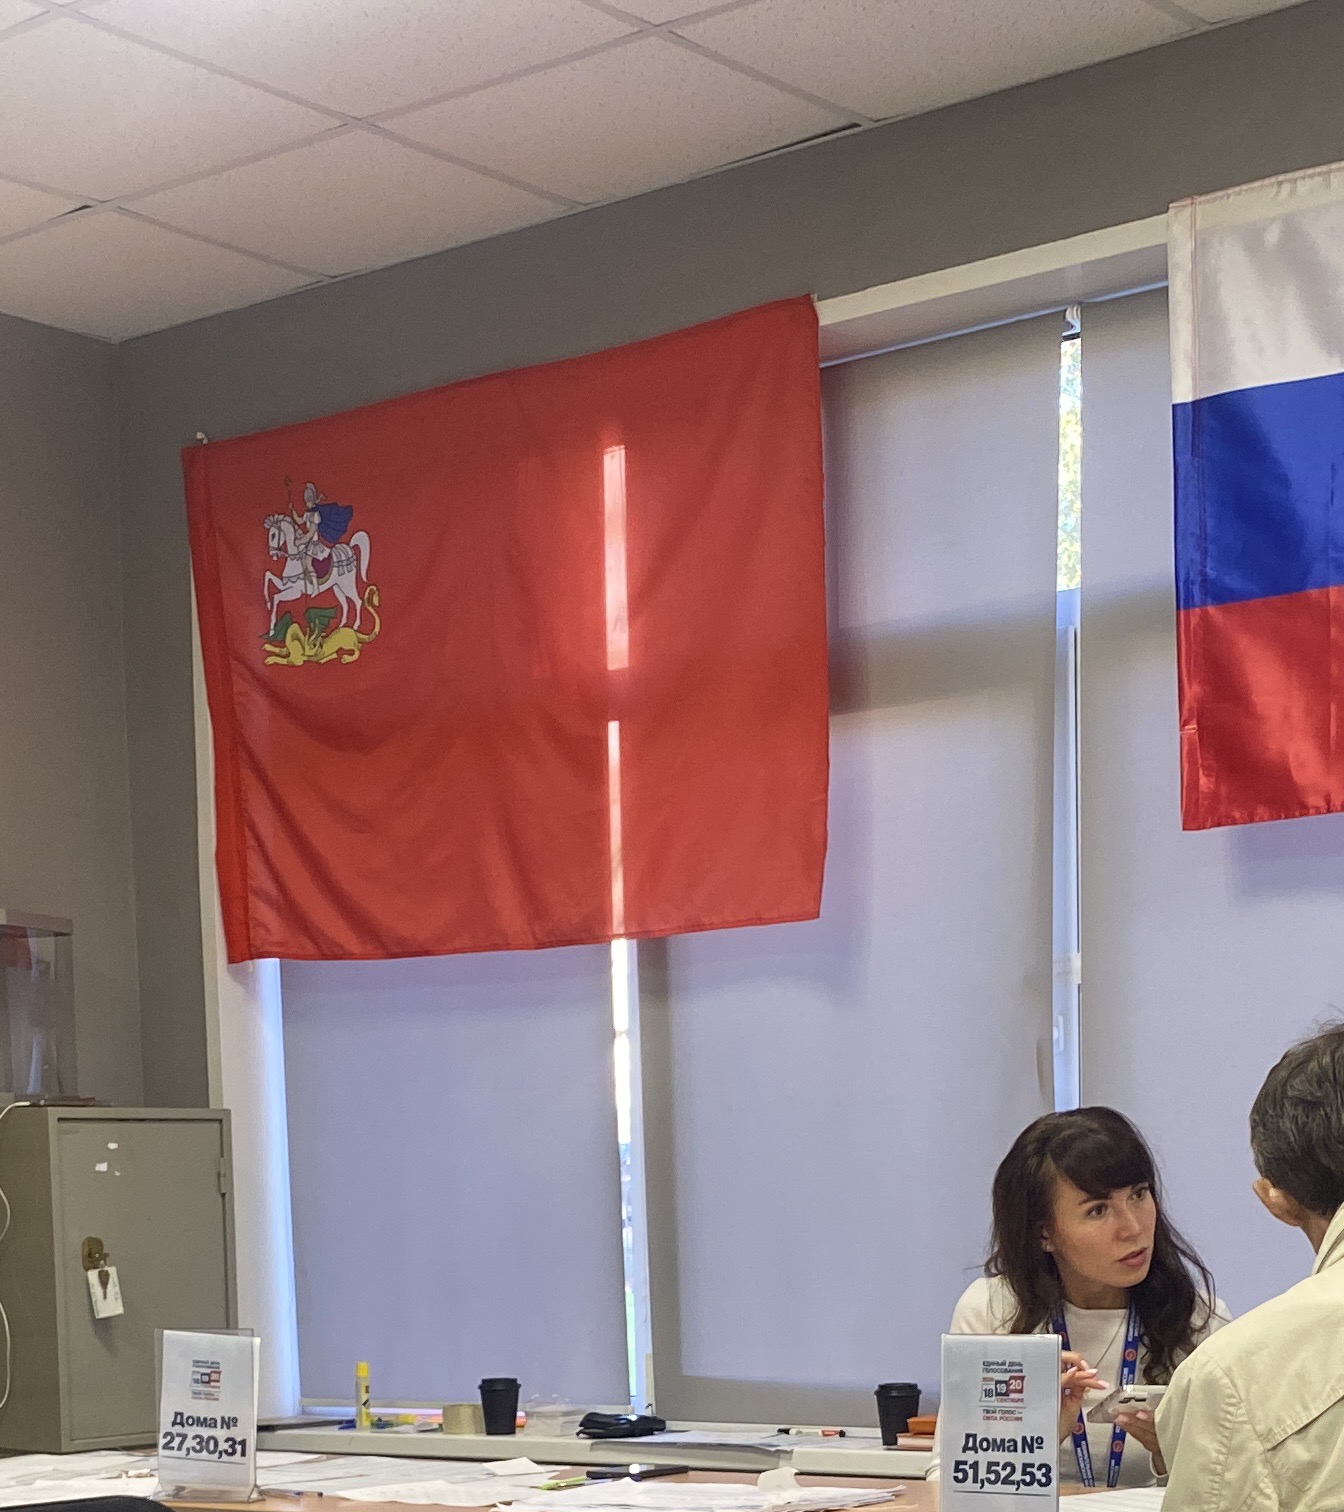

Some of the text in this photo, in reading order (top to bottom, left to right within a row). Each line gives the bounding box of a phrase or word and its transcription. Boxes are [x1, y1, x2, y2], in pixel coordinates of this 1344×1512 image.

[983, 1379, 1022, 1398] 18 19 20
[171, 1411, 239, 1430] Дома №
[162, 1431, 247, 1459] 27,30,31
[962, 1433, 1044, 1454] Дома №
[952, 1460, 1052, 1491] 51,52,53
